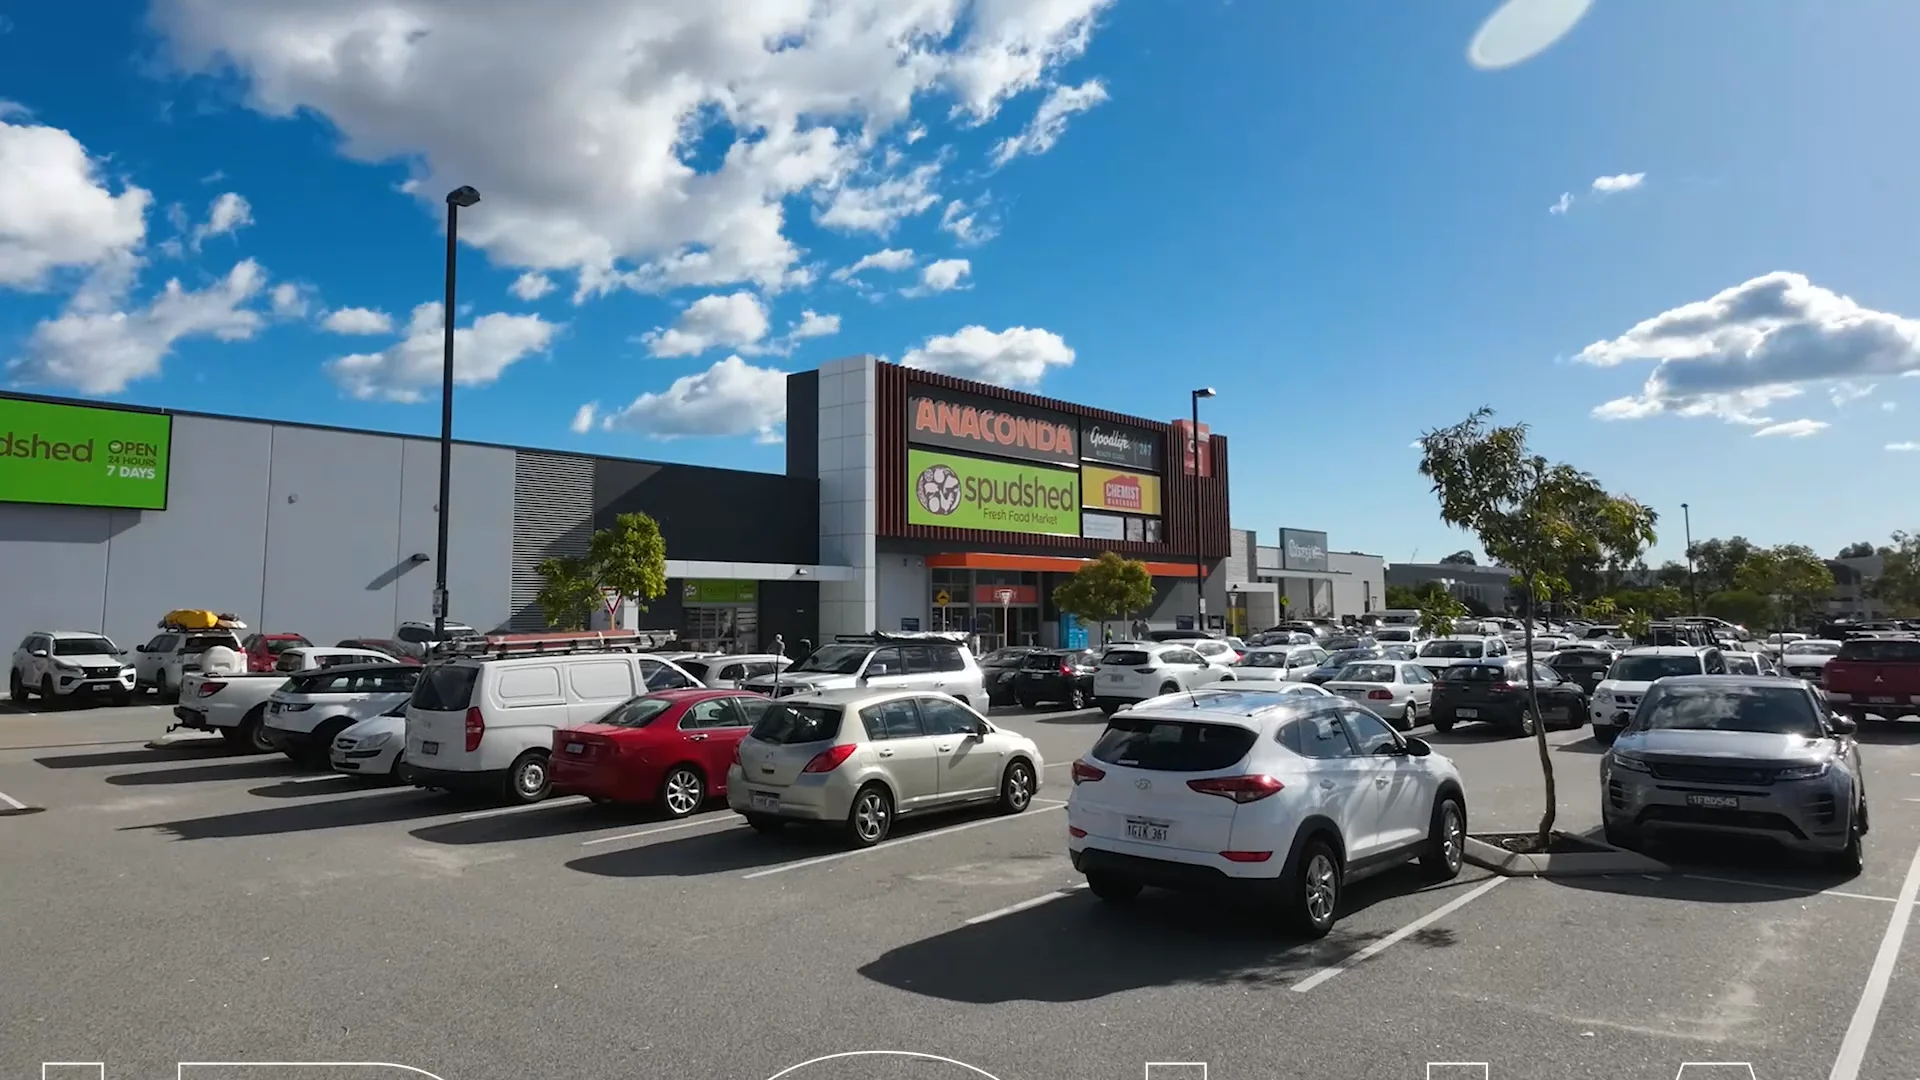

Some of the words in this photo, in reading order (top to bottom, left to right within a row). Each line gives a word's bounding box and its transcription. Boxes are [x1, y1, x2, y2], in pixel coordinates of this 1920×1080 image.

[915, 397, 1074, 456] ANACONDA
[107, 439, 157, 457] OPEN
[108, 455, 120, 464] 24
[122, 456, 157, 467] HOURS
[106, 465, 116, 477] 7
[119, 467, 156, 480] DAYS
[964, 473, 1073, 512] spudshed
[1105, 483, 1140, 500] CHEMIST
[983, 507, 1007, 521] Fresh
[1008, 510, 1030, 523] Food
[1031, 513, 1058, 526] Market
